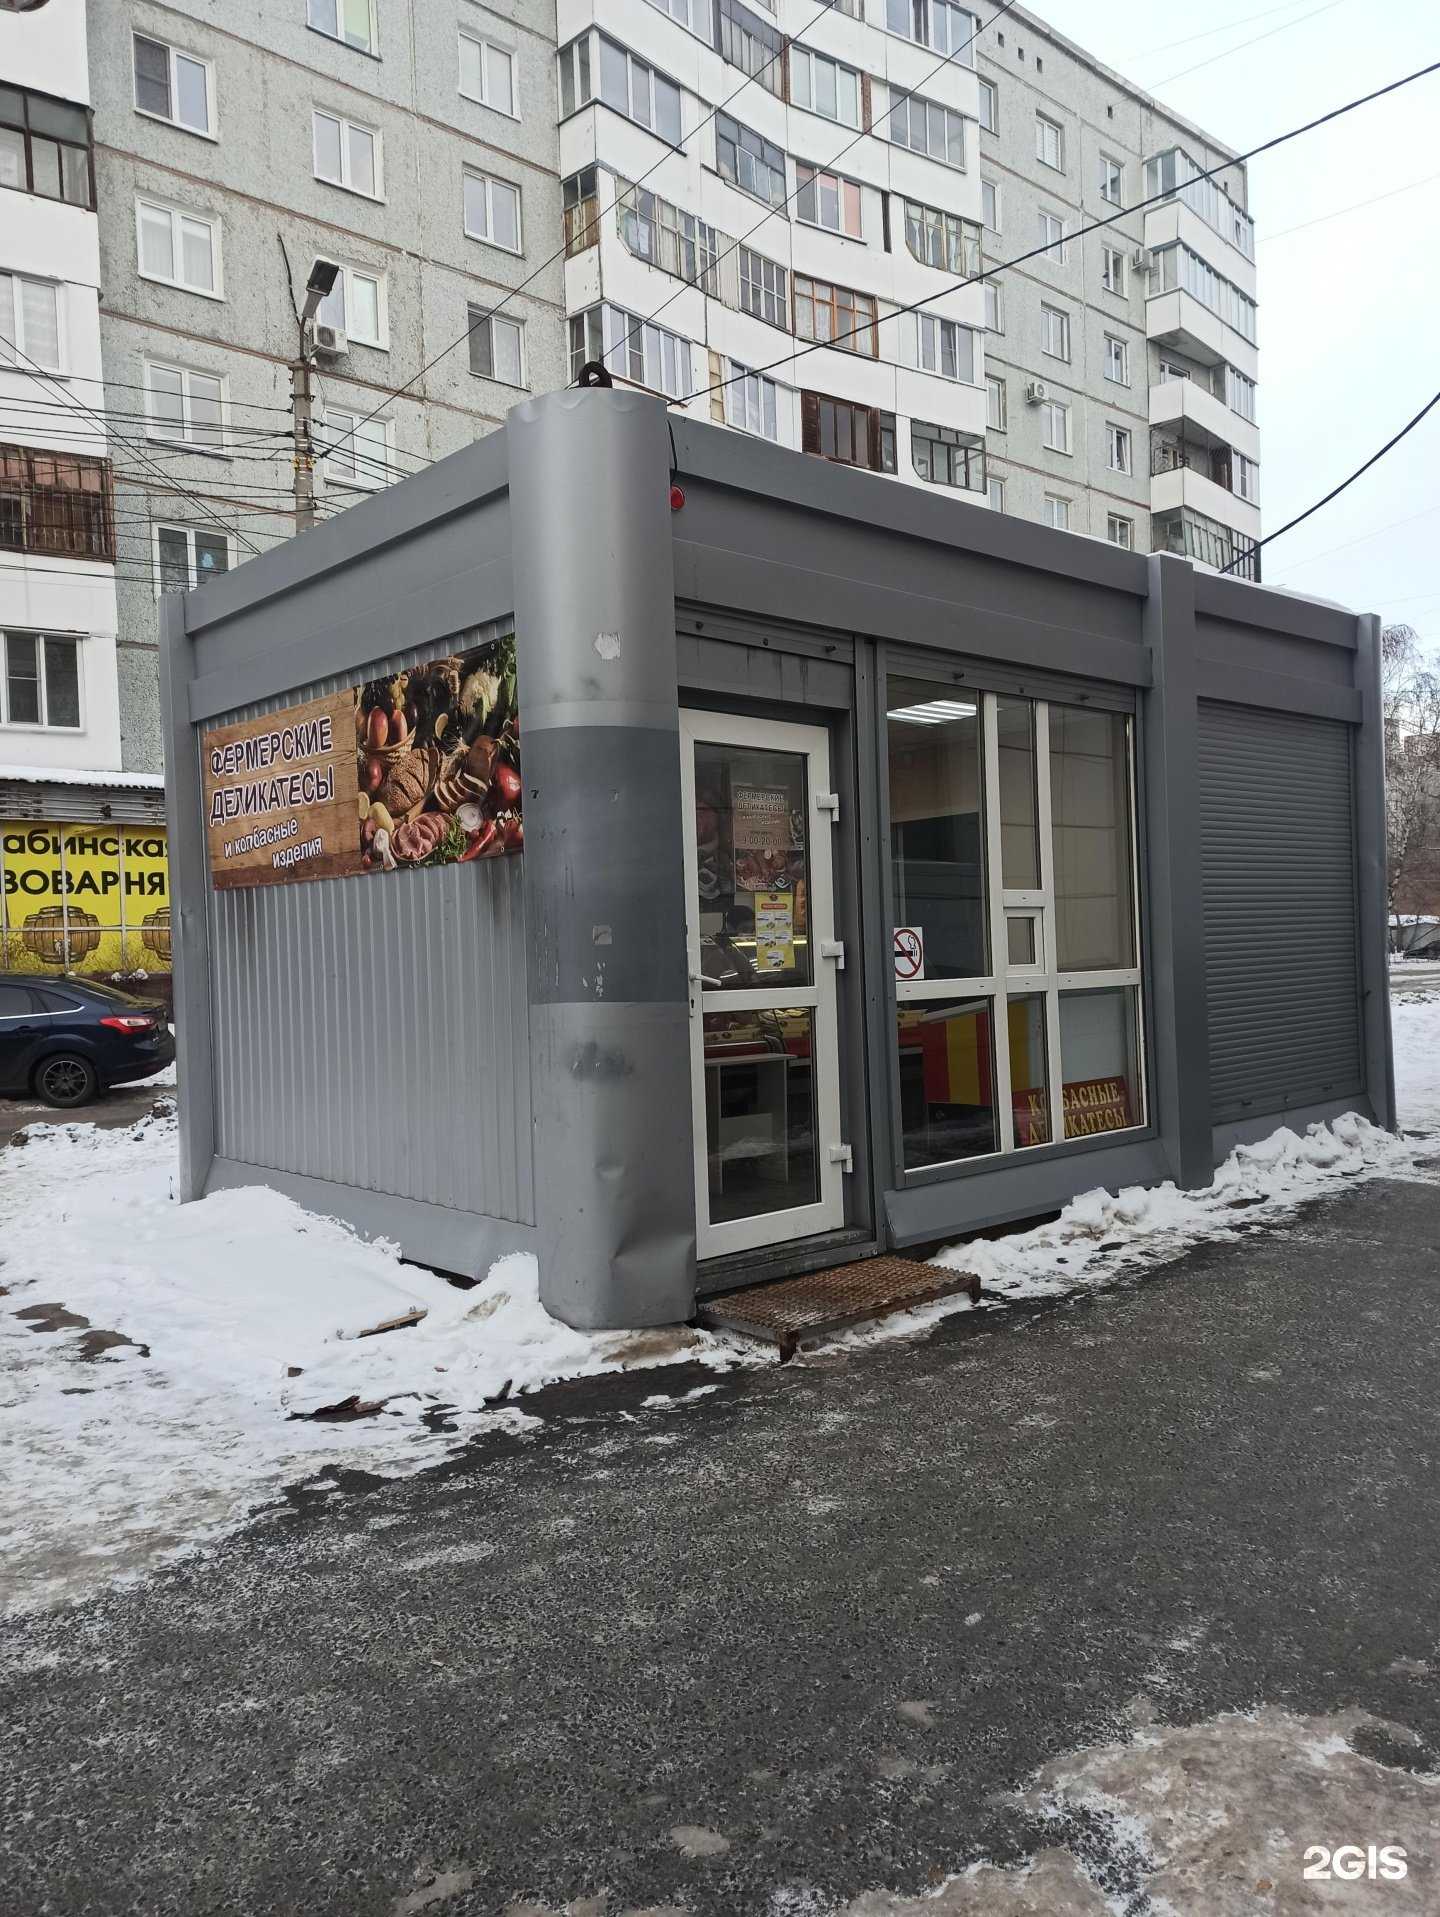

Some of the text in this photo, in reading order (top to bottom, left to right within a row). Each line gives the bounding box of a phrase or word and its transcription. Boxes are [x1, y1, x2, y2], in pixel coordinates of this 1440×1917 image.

[211, 717, 332, 777] ФЕРМЕРСКИЕ
[210, 766, 334, 826] ДЕЛИКАТЕСЫ
[3, 829, 168, 857] абинска
[225, 818, 298, 858] и колбасные
[272, 838, 322, 868] изделия
[1028, 1082, 1120, 1116] КОБАСНЫЕ
